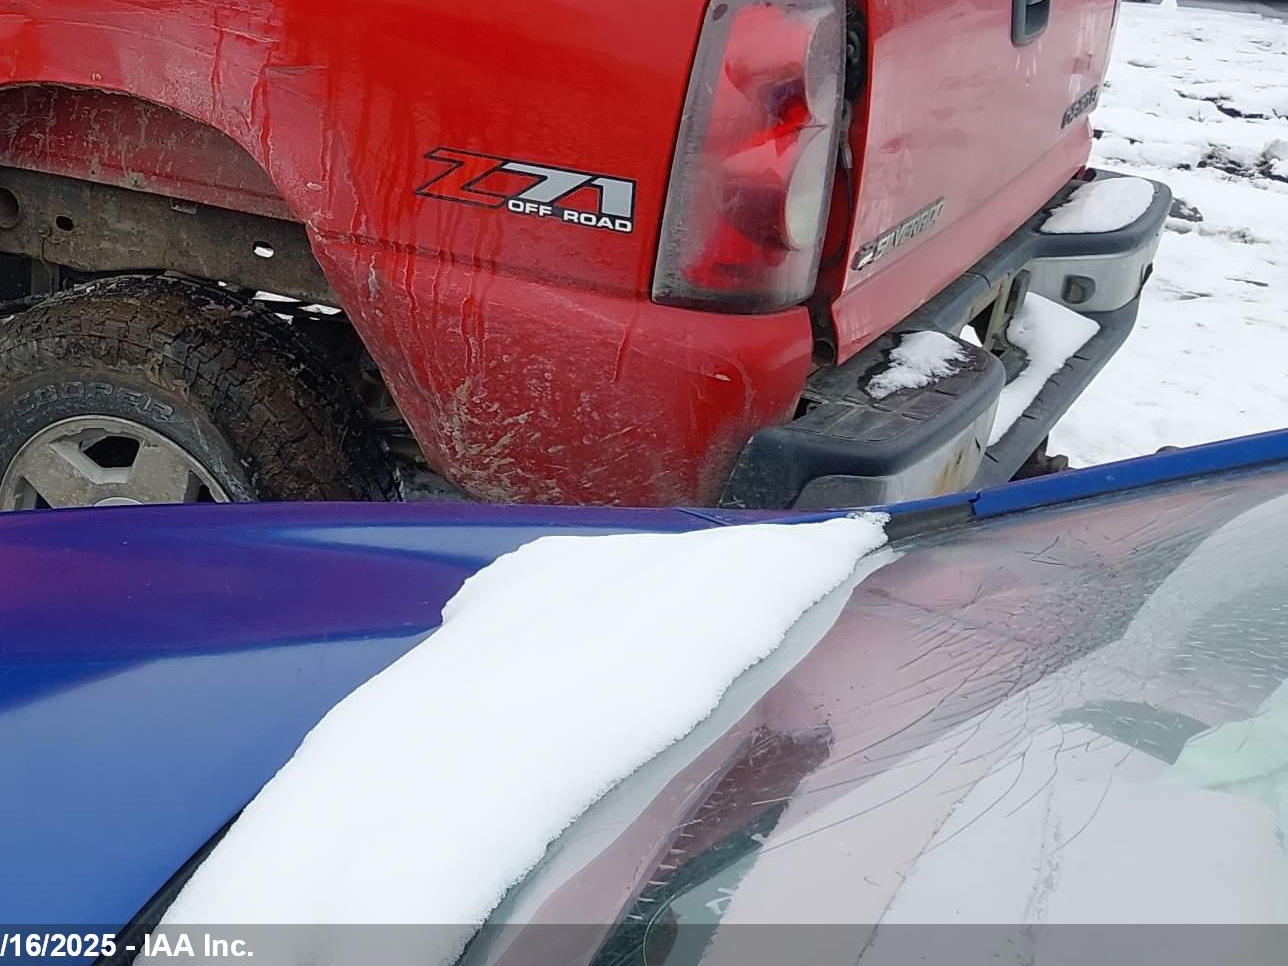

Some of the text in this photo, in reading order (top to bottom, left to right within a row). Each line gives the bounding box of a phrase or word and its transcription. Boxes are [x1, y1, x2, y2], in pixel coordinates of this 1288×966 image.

[414, 146, 637, 219] Z71
[507, 199, 632, 232] OFF ROAD
